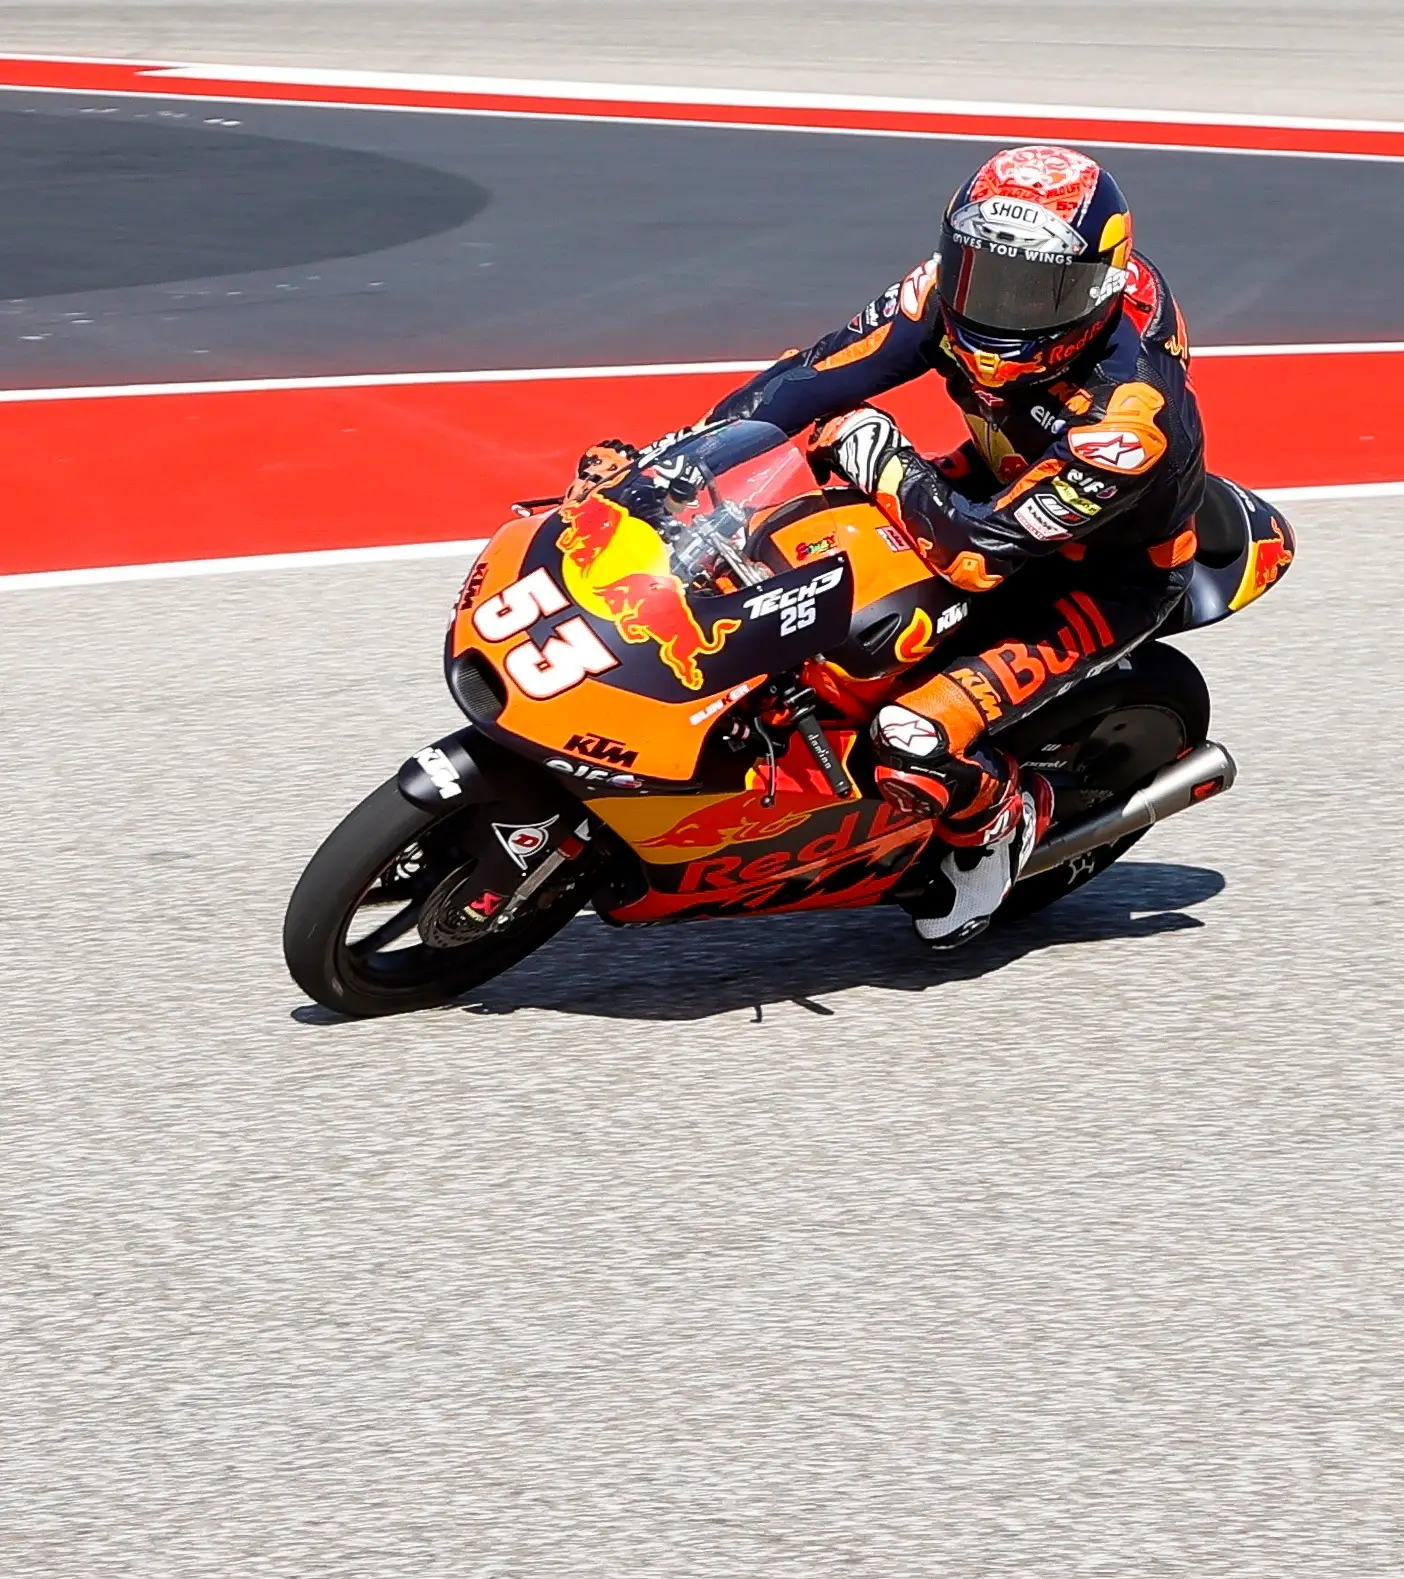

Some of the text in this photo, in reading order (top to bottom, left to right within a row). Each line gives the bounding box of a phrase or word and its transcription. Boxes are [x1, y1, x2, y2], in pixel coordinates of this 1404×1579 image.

[989, 243, 1018, 257] YOU
[1024, 250, 1073, 265] WINGS
[1067, 469, 1105, 493] elf
[460, 562, 489, 610] KTM
[743, 567, 843, 619] TECH3
[472, 565, 623, 700] 53
[780, 598, 816, 637] 25
[936, 601, 968, 634] KTM
[979, 590, 1114, 705] Bull
[949, 668, 1003, 721] KTM
[412, 747, 462, 799] KTM
[563, 732, 639, 768] KTM
[808, 734, 832, 769] domino
[677, 811, 860, 893] Red
